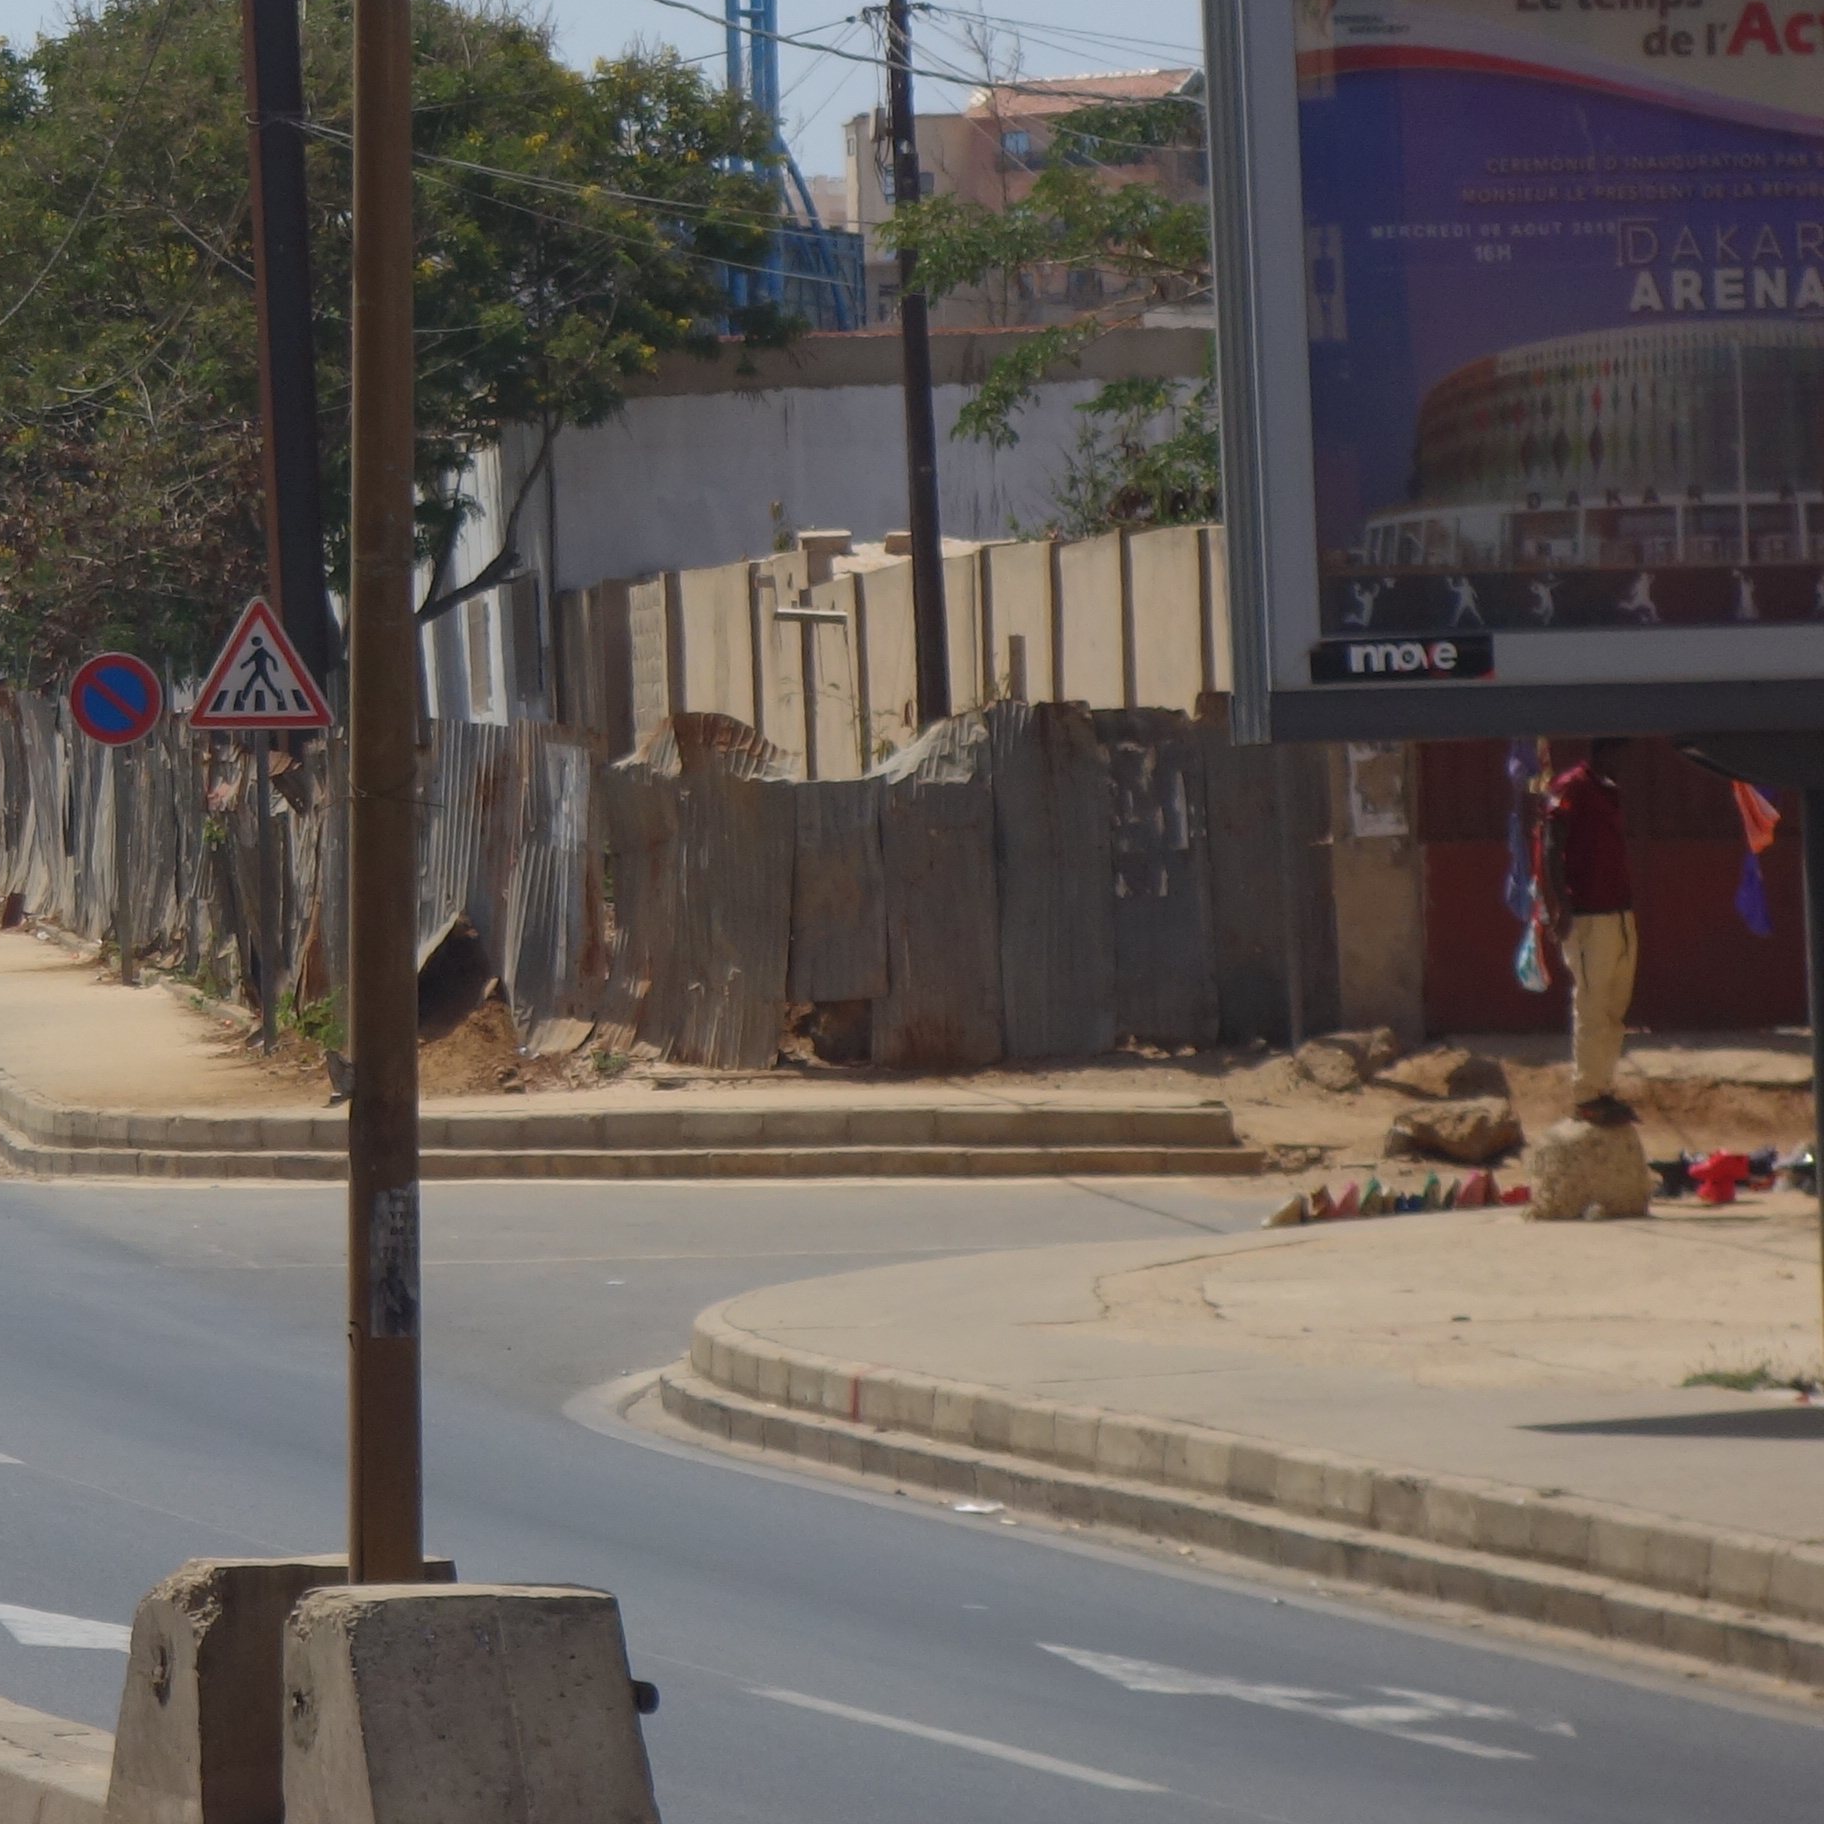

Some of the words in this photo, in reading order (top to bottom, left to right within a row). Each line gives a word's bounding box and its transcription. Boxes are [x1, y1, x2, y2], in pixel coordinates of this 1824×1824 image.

[1642, 25, 1694, 57] de
[1461, 186, 1559, 205] MONSIEUR
[1565, 186, 1587, 202] LE
[1701, 183, 1725, 199] DE
[1733, 182, 1755, 198] LA
[1370, 222, 1472, 239] MERCREDI
[1626, 218, 1824, 266] DAKAR
[1473, 242, 1512, 264] 16H
[1629, 266, 1824, 312] ARENA
